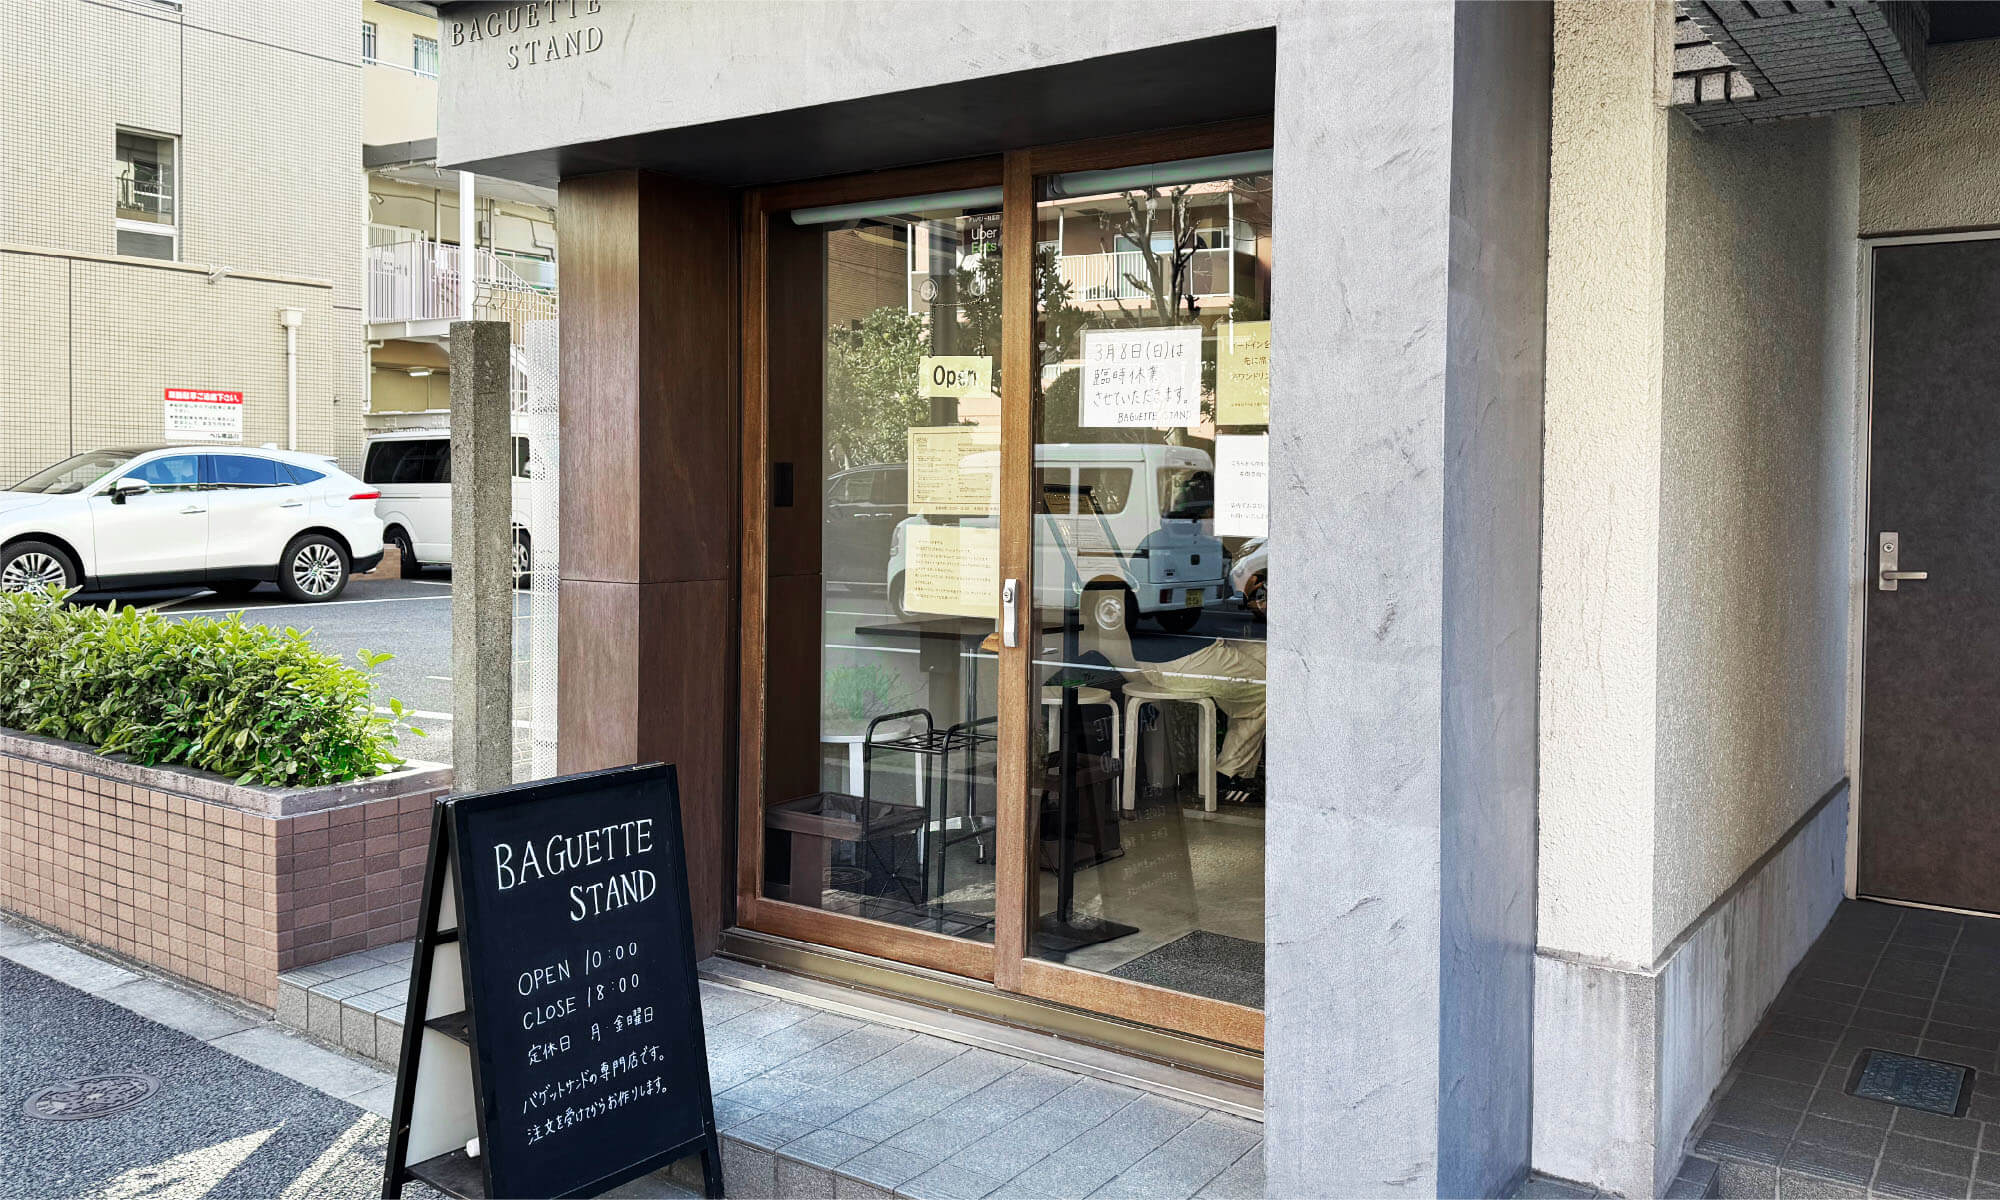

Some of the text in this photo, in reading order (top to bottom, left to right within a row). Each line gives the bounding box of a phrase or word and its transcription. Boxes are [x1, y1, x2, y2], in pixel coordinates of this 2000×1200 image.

[451, 0, 601, 47] BAGUETTE
[506, 25, 603, 70] STAND
[971, 227, 998, 240] Uber
[933, 365, 977, 388] Open
[1093, 366, 1158, 386] 臨時休業
[1118, 409, 1191, 424] BAGUETTE TAN
[493, 818, 653, 891] BAGUETTE
[569, 869, 656, 922] STAND
[518, 942, 638, 996] OPEN 10:00
[522, 973, 640, 1030] CLOSE 18:00
[528, 1035, 571, 1066] 定休日
[523, 1045, 665, 1114] バゲットサンドの専門店です。
[528, 1076, 667, 1145] 注文を受けてからお作りします。
